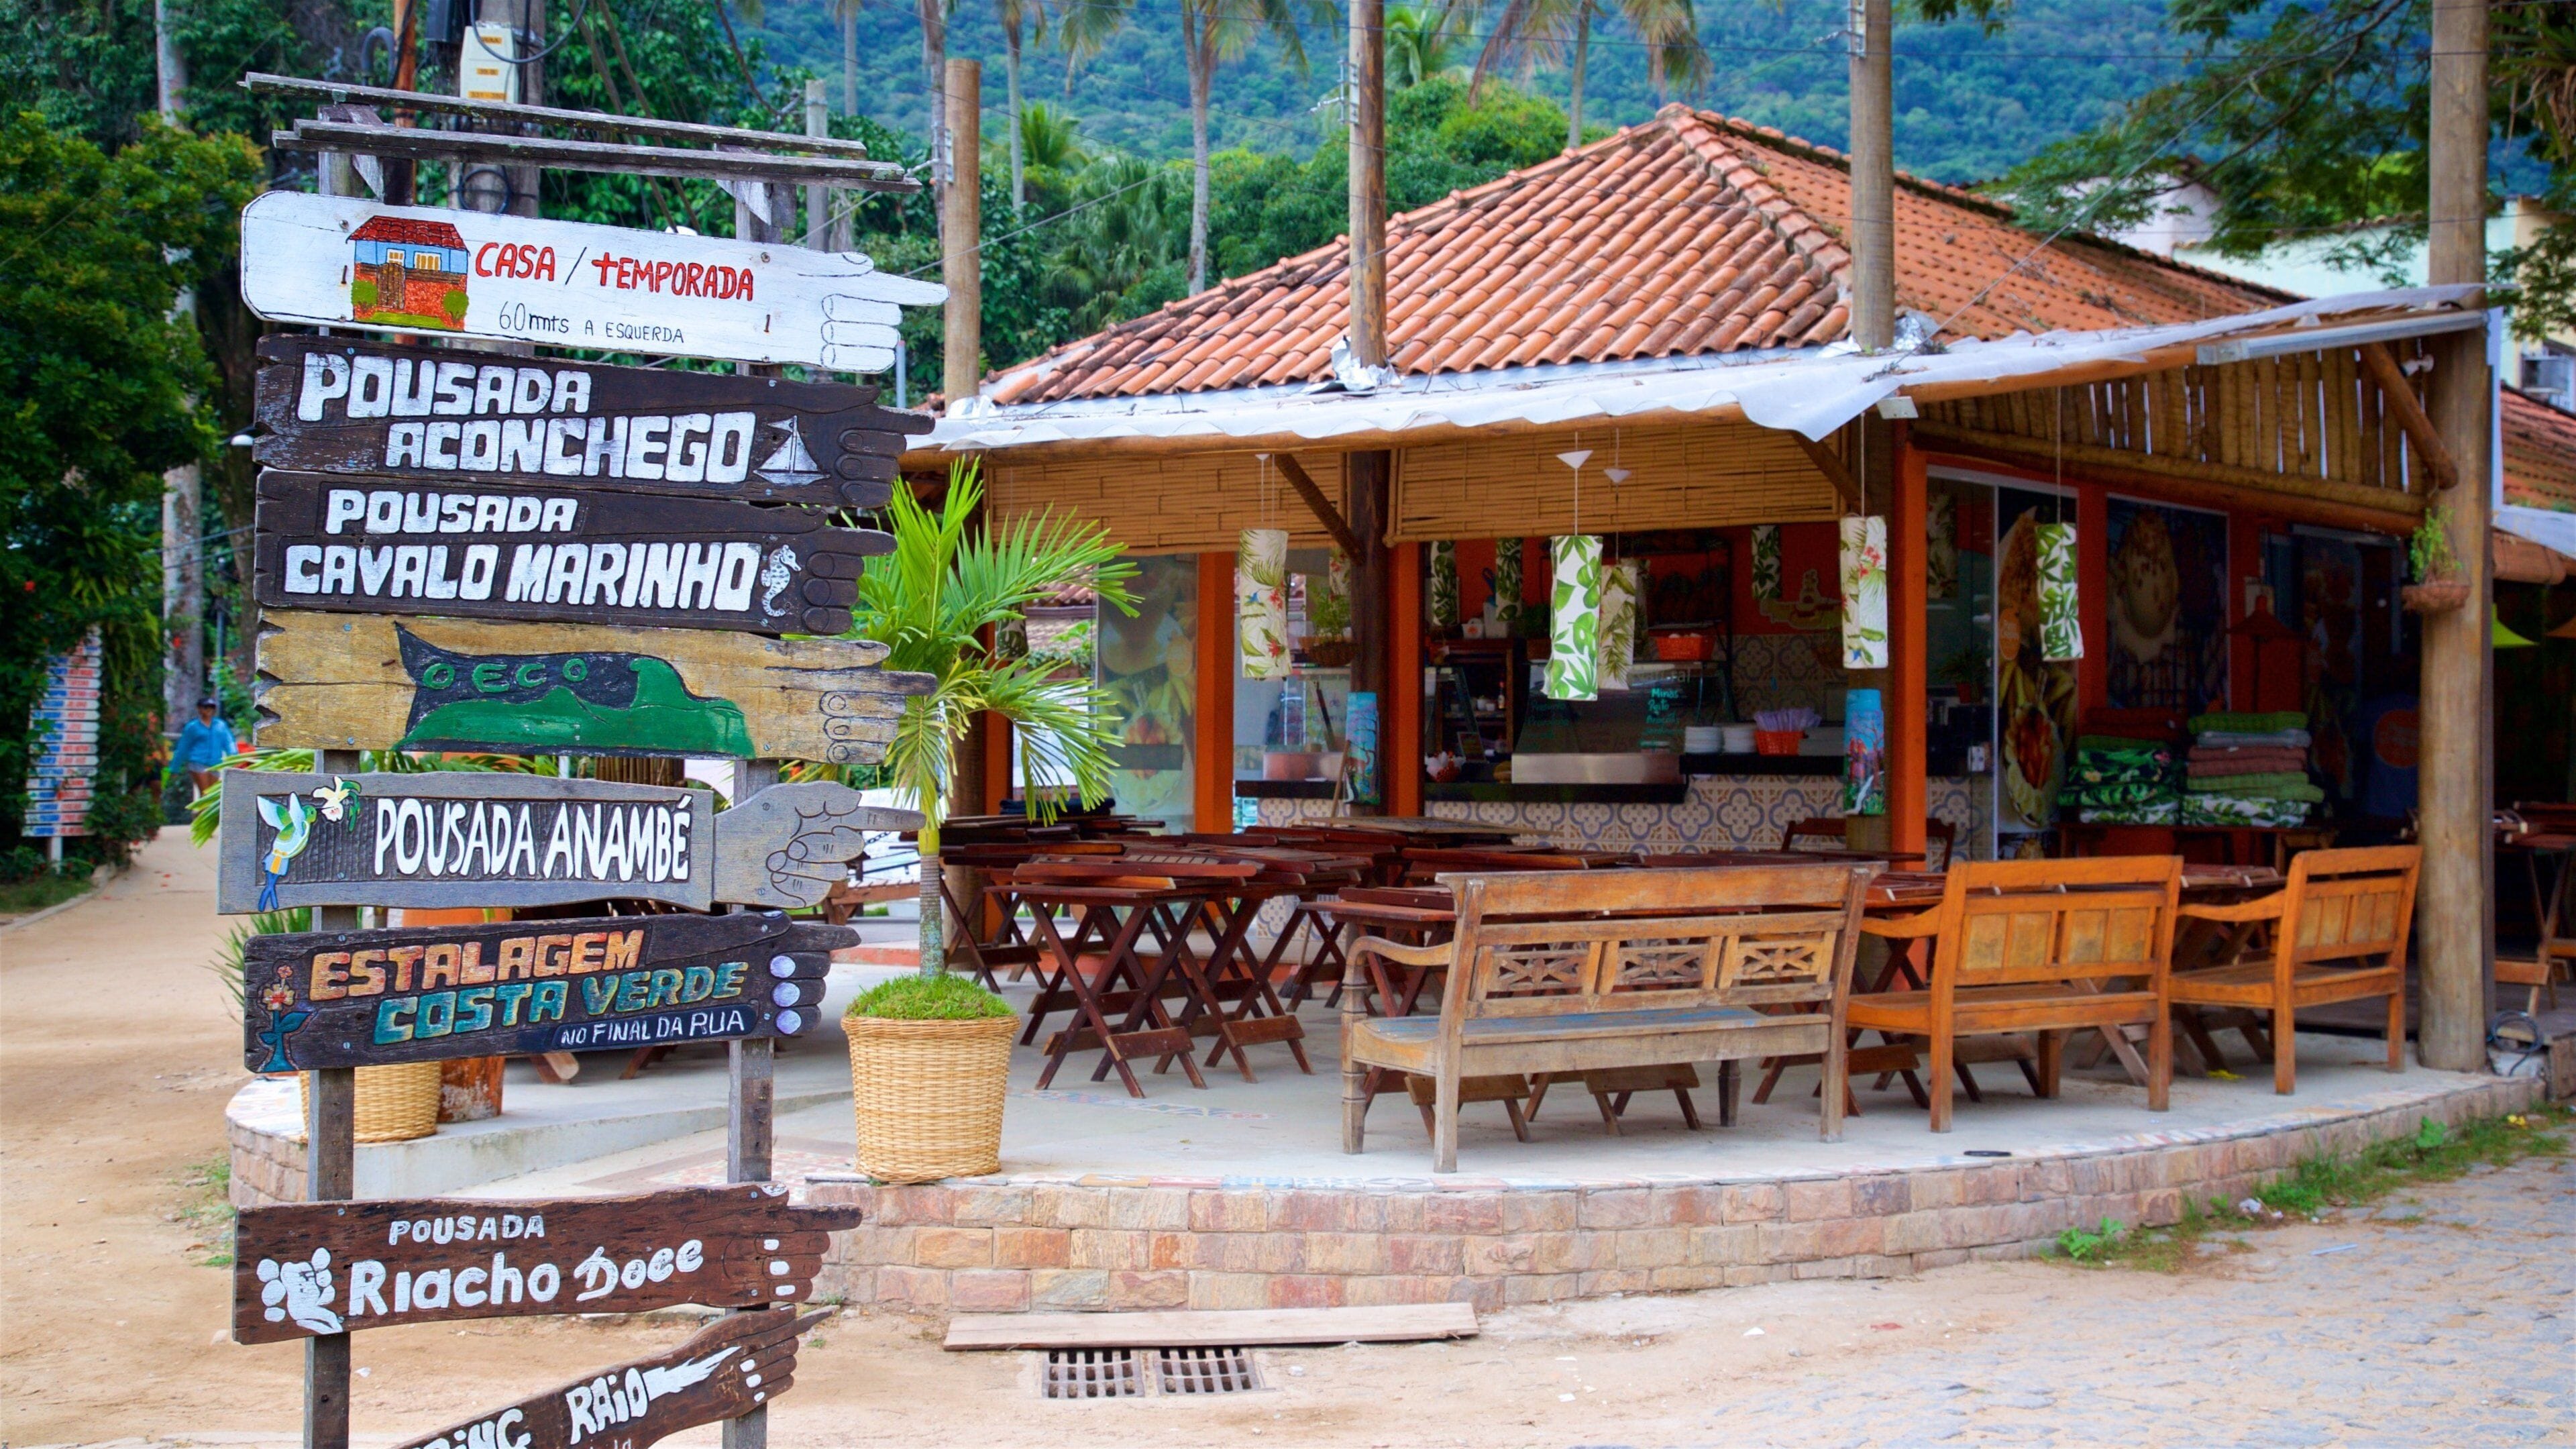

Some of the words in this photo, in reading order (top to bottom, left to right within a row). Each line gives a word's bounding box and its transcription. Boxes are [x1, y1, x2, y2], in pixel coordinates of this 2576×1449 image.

[474, 242, 556, 282] CASA
[590, 252, 753, 301] TEMPORADA
[584, 319, 594, 336] A
[605, 322, 685, 344] ESQUERDA
[297, 352, 593, 421] POUSADA
[384, 411, 758, 484] ACONCHEGO
[325, 488, 578, 535] POUSADA
[284, 543, 499, 601] CAVALO
[504, 541, 762, 612] MARINHO
[373, 797, 537, 877] POUSADA
[542, 795, 692, 883] ANAMBÉ
[309, 929, 645, 1002] ESTALAGEM
[374, 980, 569, 1046] COSTA
[582, 960, 749, 1016] VERDE
[559, 1027, 587, 1045] NO
[590, 1021, 651, 1044] FINAL
[655, 1016, 689, 1038] DA
[691, 1009, 747, 1037] RUA
[388, 1214, 545, 1246] POUSADA
[348, 1251, 561, 1318] Riacho
